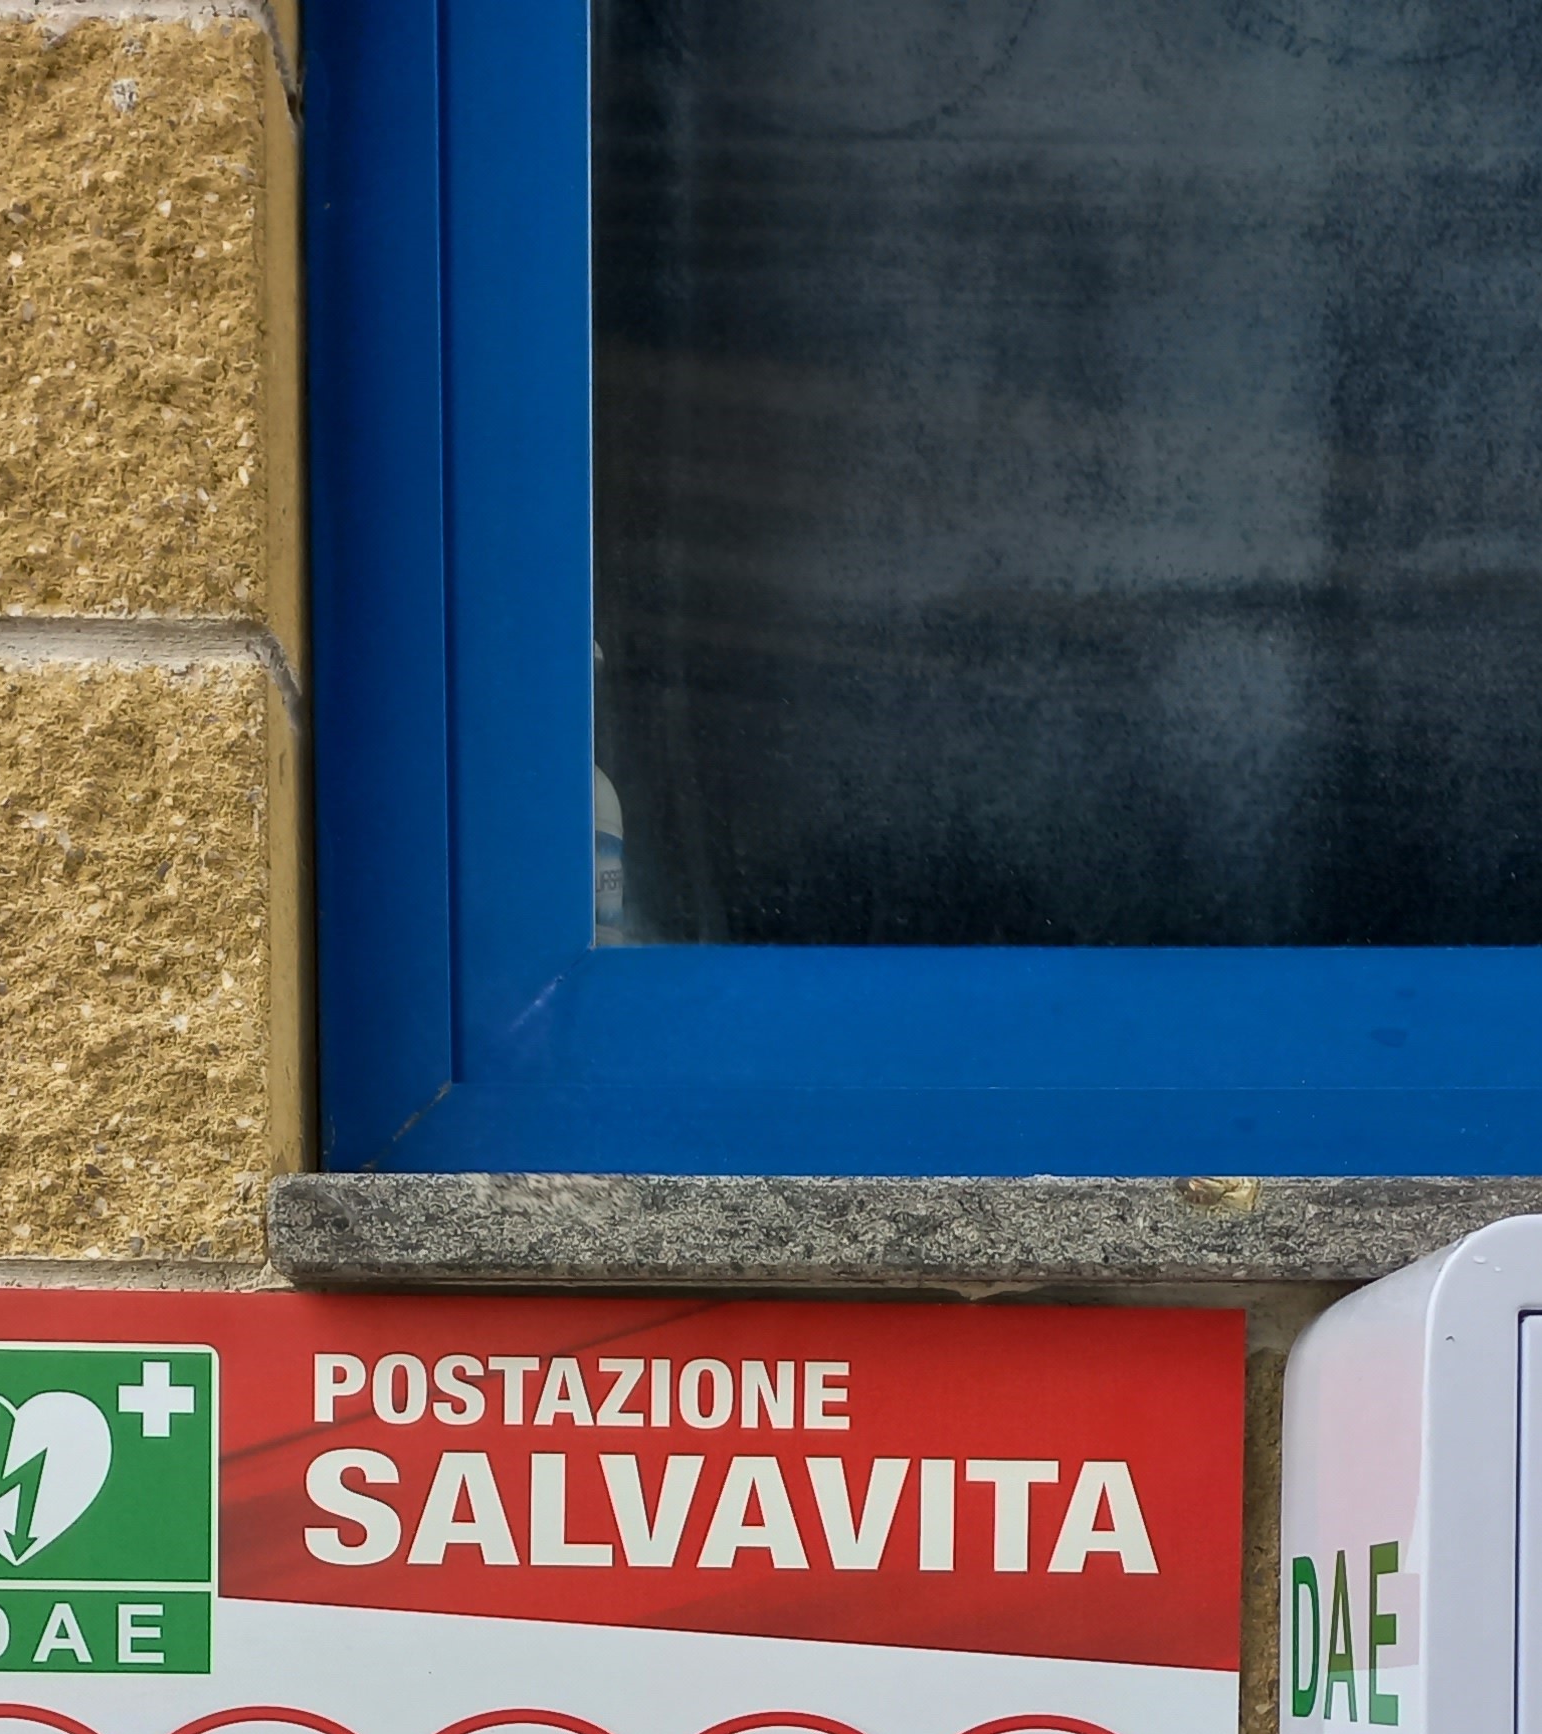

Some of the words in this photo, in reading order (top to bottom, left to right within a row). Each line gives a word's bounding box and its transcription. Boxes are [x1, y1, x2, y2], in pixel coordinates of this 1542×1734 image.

[315, 1352, 851, 1430] POSTAZIONE
[303, 1448, 1158, 1573] SALVAVITA
[1292, 1540, 1399, 1727] DAE
